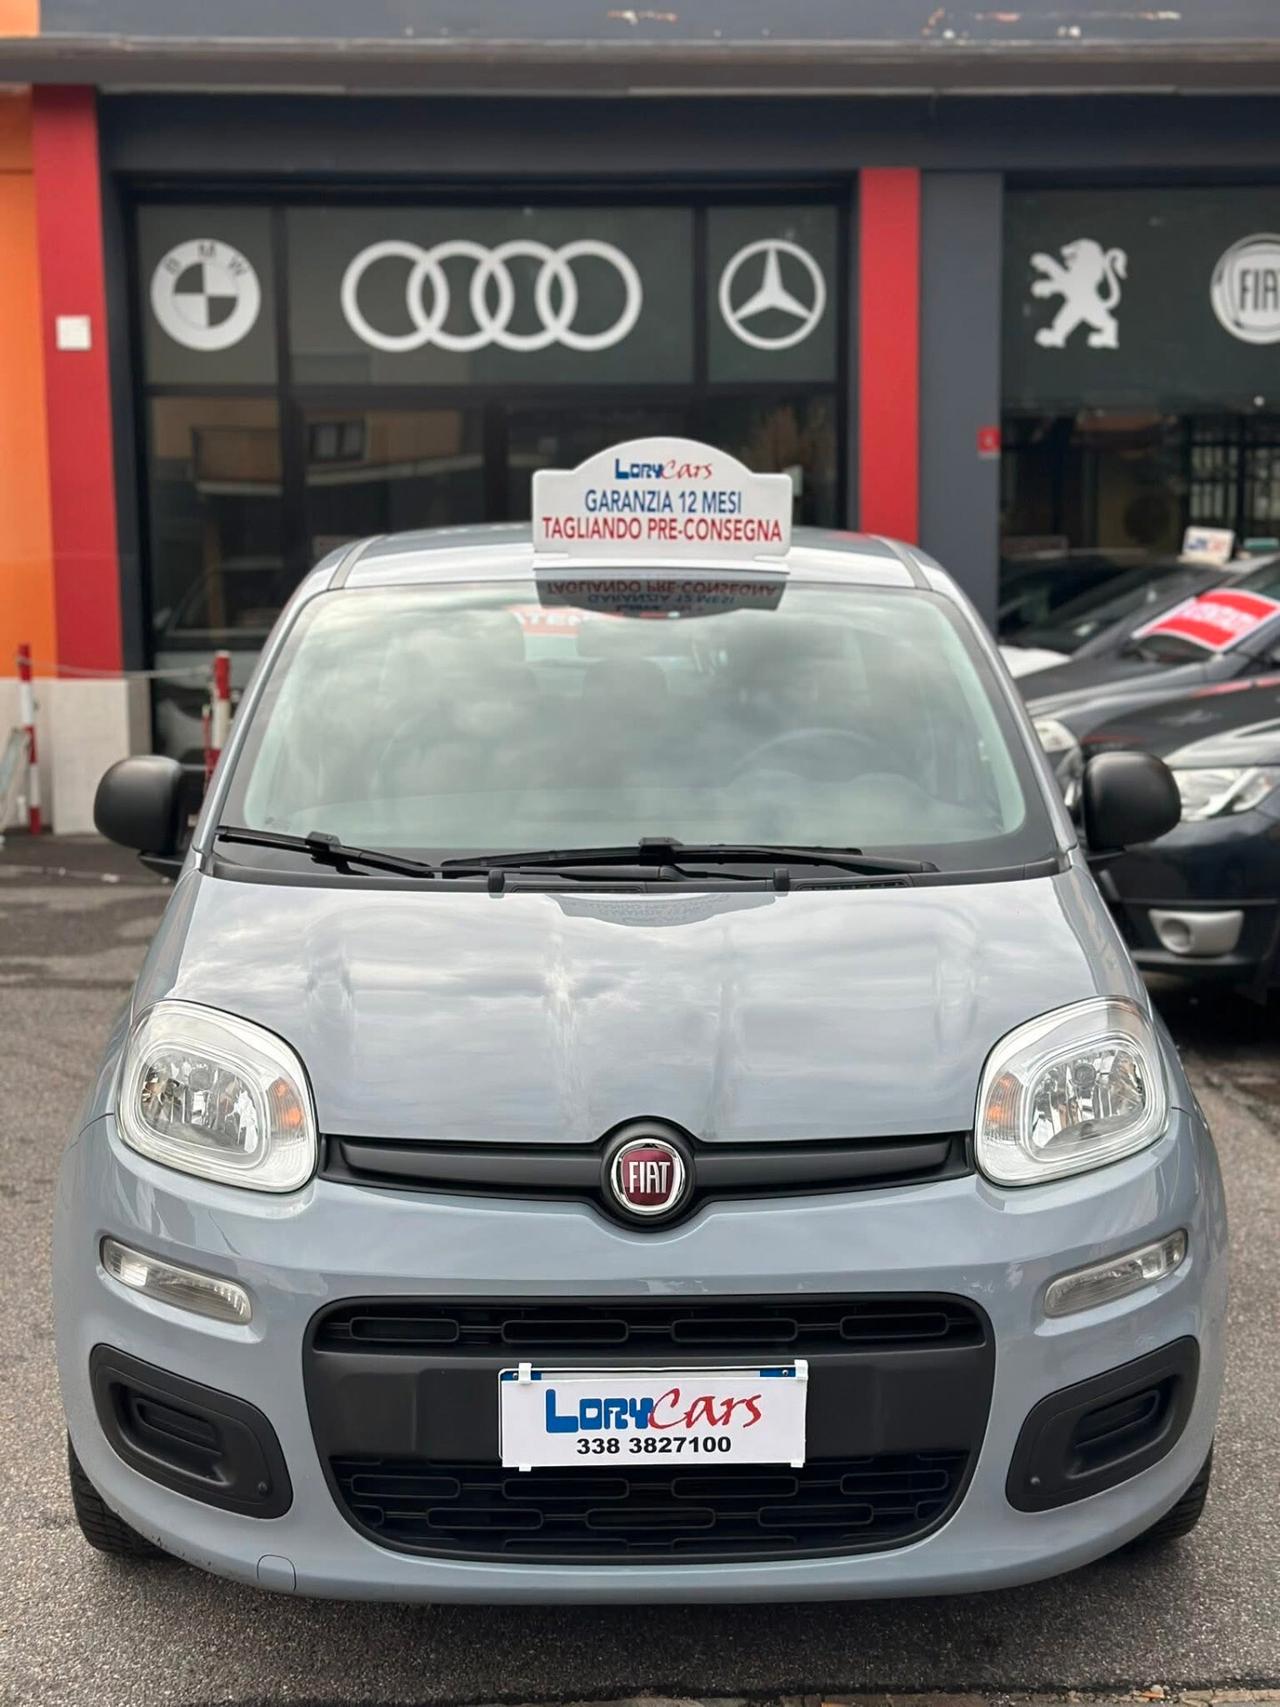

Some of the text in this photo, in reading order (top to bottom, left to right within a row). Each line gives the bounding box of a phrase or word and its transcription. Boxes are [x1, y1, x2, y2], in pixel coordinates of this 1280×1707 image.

[1240, 267, 1280, 312] FIA
[585, 489, 742, 514] GARANZIA 12 MESI
[542, 516, 783, 542] TAGLIANDO PRE-CONSEGNA
[628, 1161, 671, 1194] FIAT
[576, 1436, 732, 1455] 338 3827100
